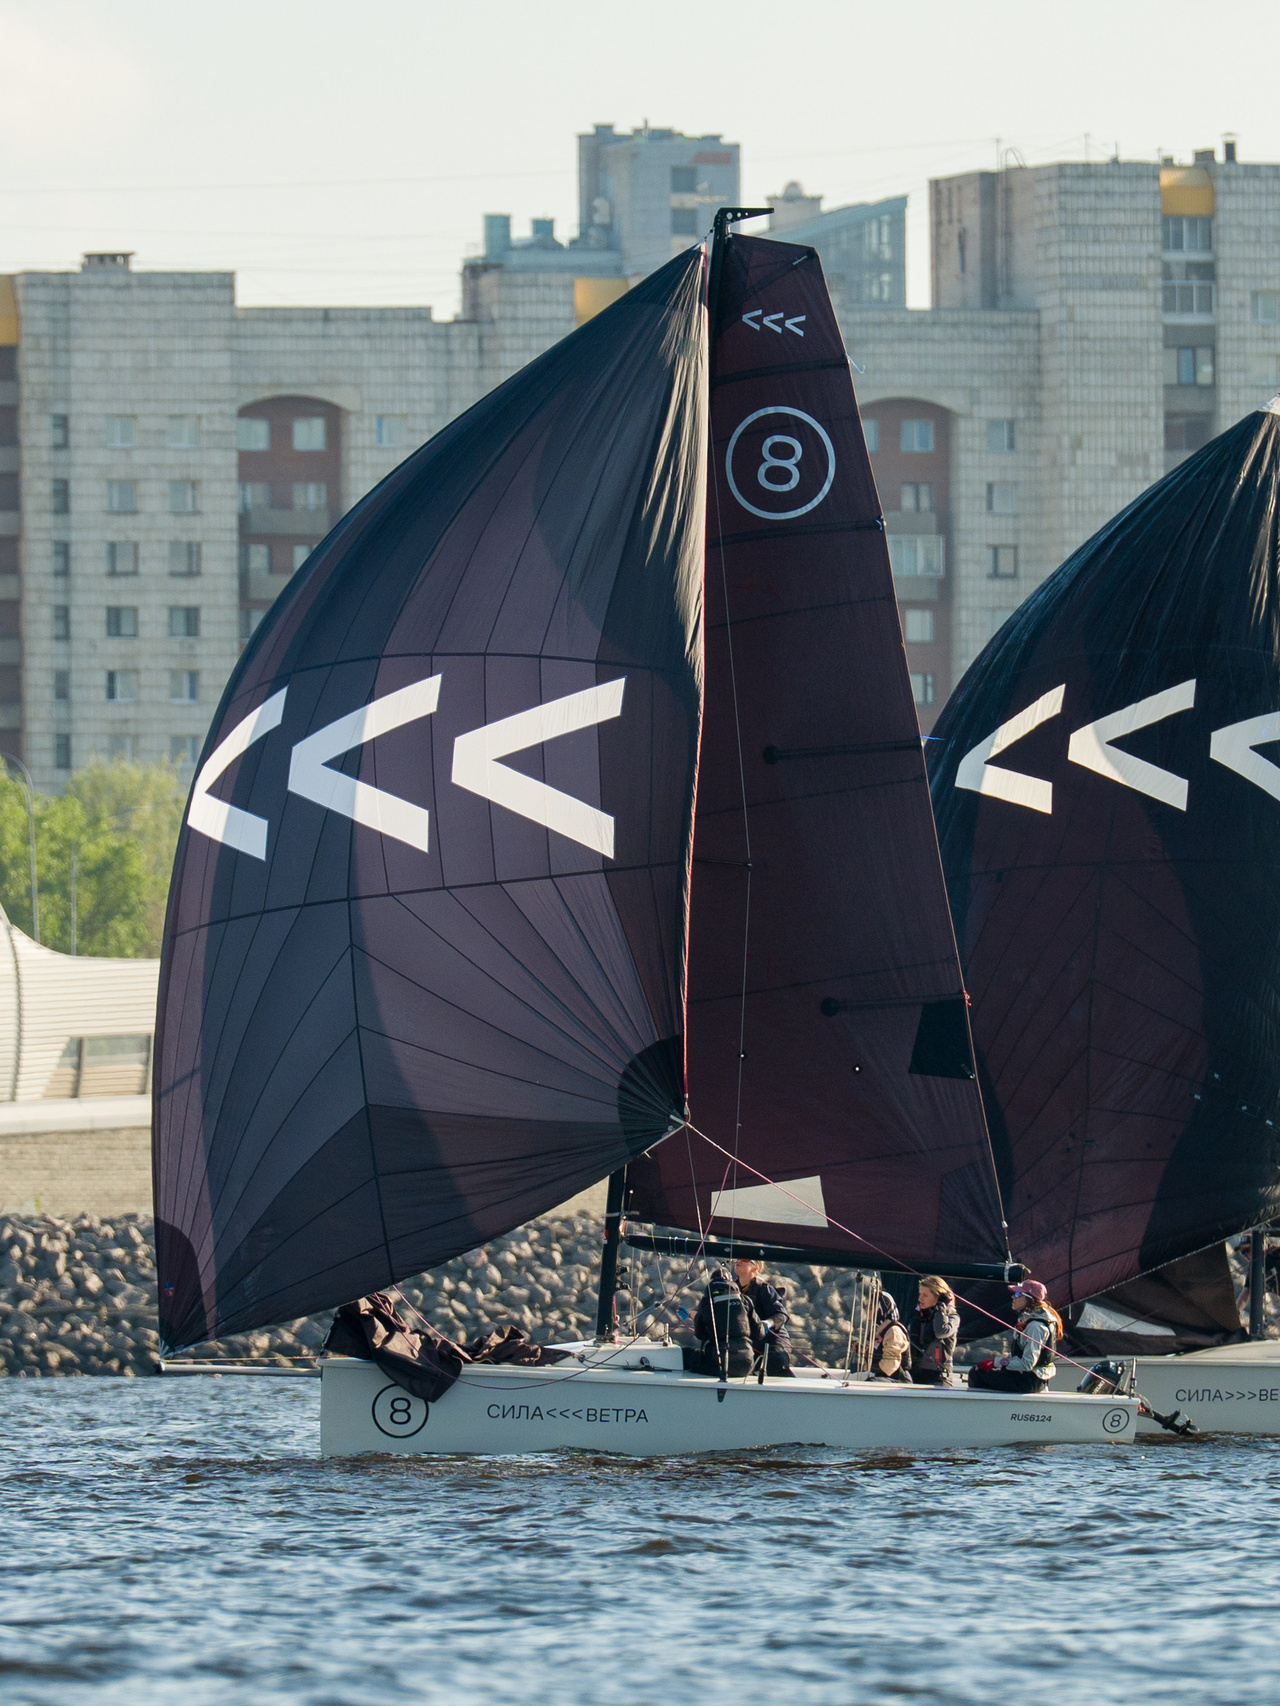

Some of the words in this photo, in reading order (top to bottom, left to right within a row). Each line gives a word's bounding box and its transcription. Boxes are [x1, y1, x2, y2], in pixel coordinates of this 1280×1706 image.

[758, 436, 803, 492] 8
[389, 1397, 412, 1425] 8
[1010, 1413, 1052, 1423] RUS6124
[1110, 1414, 1122, 1428] 8
